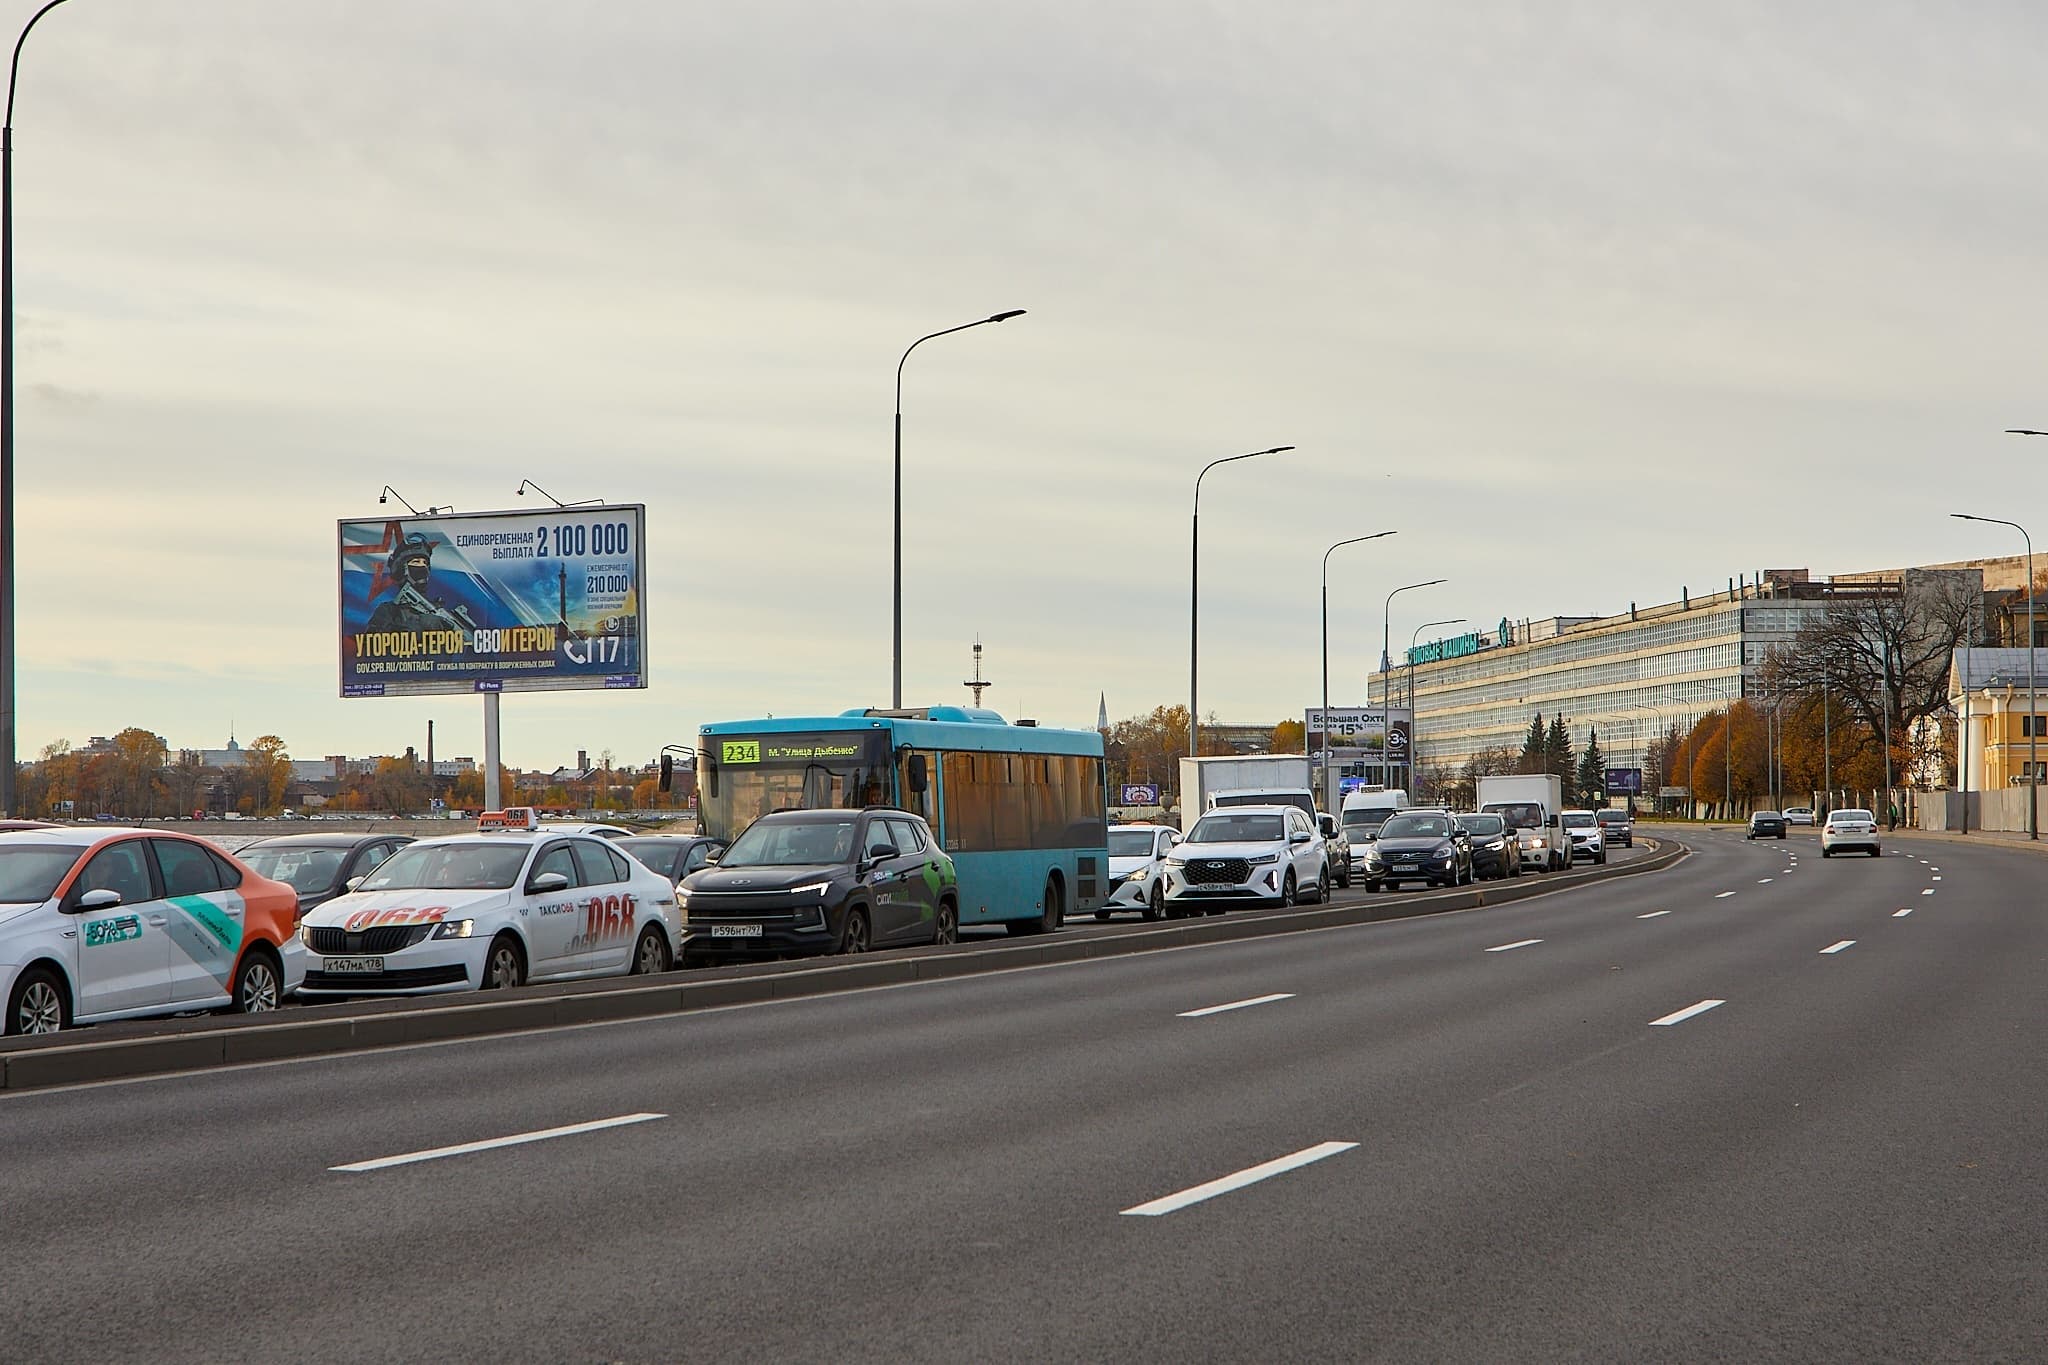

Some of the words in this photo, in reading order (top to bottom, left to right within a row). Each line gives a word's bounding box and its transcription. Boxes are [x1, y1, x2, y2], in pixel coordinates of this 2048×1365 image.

[456, 532, 534, 547] ЕДИНОВРЕМЕННАЯ
[536, 526, 548, 557] 2
[553, 525, 586, 557] 100
[591, 523, 629, 556] 000
[492, 546, 534, 559] ВЫПЛАТА
[587, 576, 605, 593] 210
[607, 575, 628, 593] 000
[355, 633, 364, 657] У
[366, 630, 463, 658] ГОРОДА-ГЕРОЯ
[473, 628, 510, 654] СВОИ
[512, 626, 556, 652] ГЕРОИ
[585, 636, 620, 663] 117
[1441, 632, 1479, 660] МАШИНЫ
[356, 660, 434, 674] GOV.SPB.RU/CONTRACT
[437, 662, 458, 671] СЛУЖБА
[465, 661, 493, 670] КОНТРАКТУ
[498, 660, 538, 669] ВООРУЖЕННЫХ
[538, 659, 556, 669] СИЛАХ
[1313, 714, 1359, 723] Большая
[726, 745, 756, 761] 234
[780, 747, 812, 758] "Улица
[813, 745, 858, 758] Дыбенко"
[507, 809, 525, 819] 068
[344, 906, 452, 932] 068
[587, 893, 635, 943] 068
